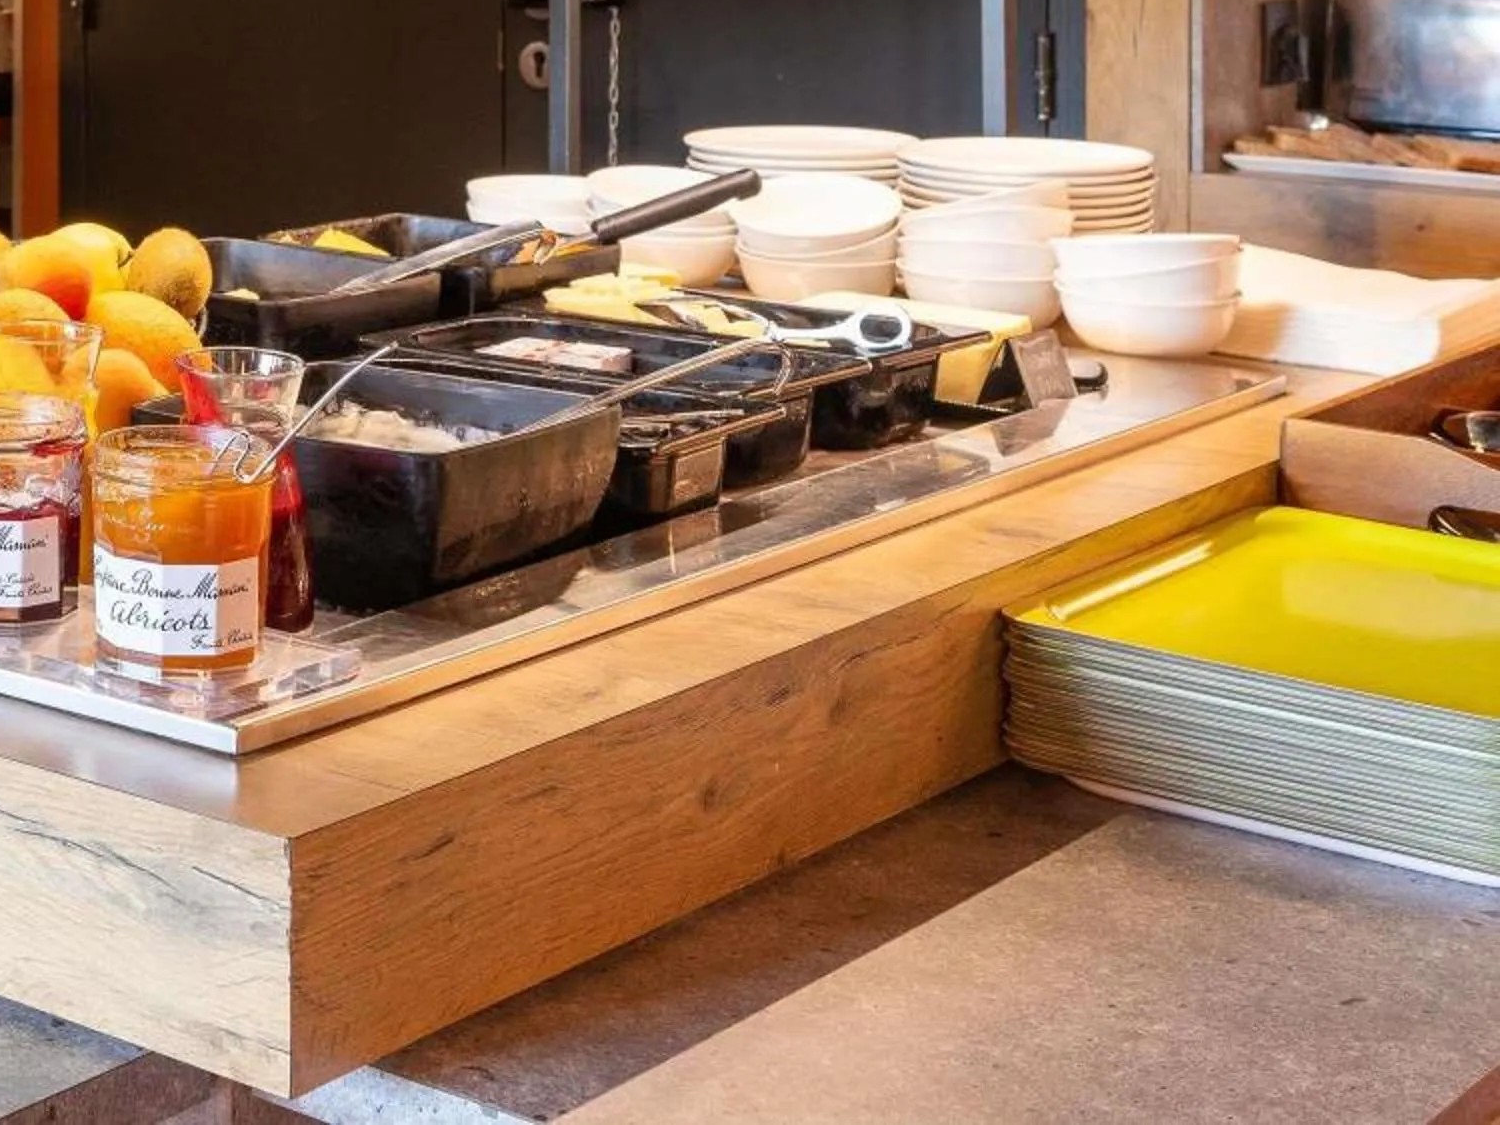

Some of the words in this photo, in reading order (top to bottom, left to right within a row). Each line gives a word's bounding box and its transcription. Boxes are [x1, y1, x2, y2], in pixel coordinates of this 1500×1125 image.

[131, 568, 185, 599] Bonne
[186, 572, 249, 601] Maman
[109, 600, 213, 632] Abricots
